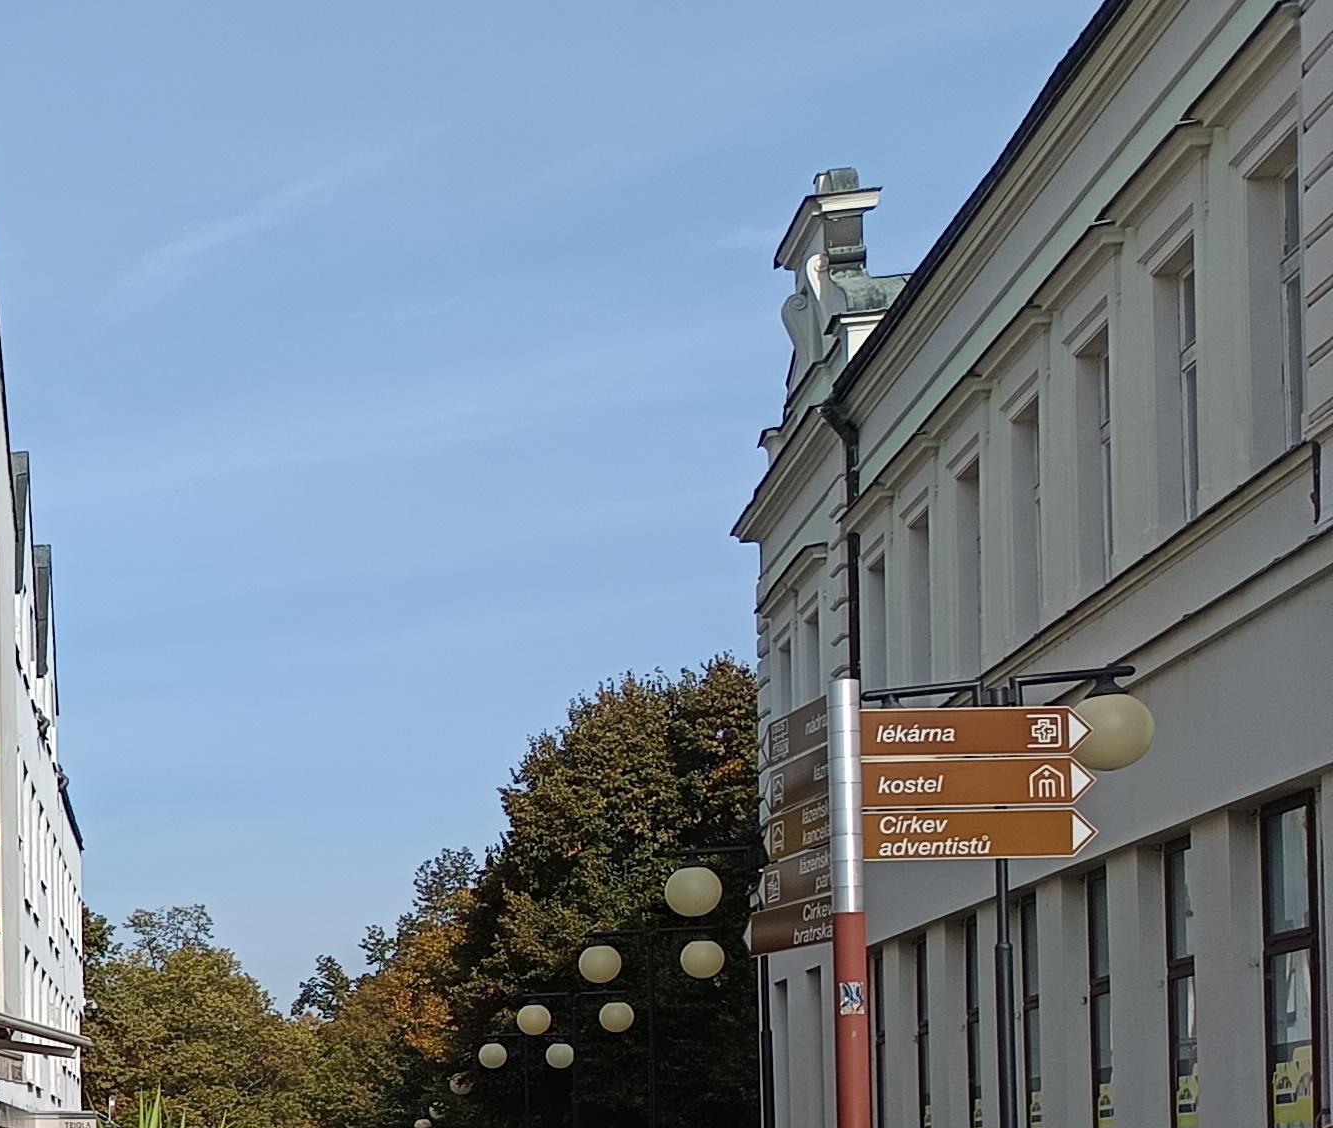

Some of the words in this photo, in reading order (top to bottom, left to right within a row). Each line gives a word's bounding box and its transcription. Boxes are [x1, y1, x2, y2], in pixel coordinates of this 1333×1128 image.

[876, 724, 955, 744] lékárna
[877, 775, 944, 795] kostel
[879, 814, 948, 835] Církev
[878, 835, 991, 857] adventistů
